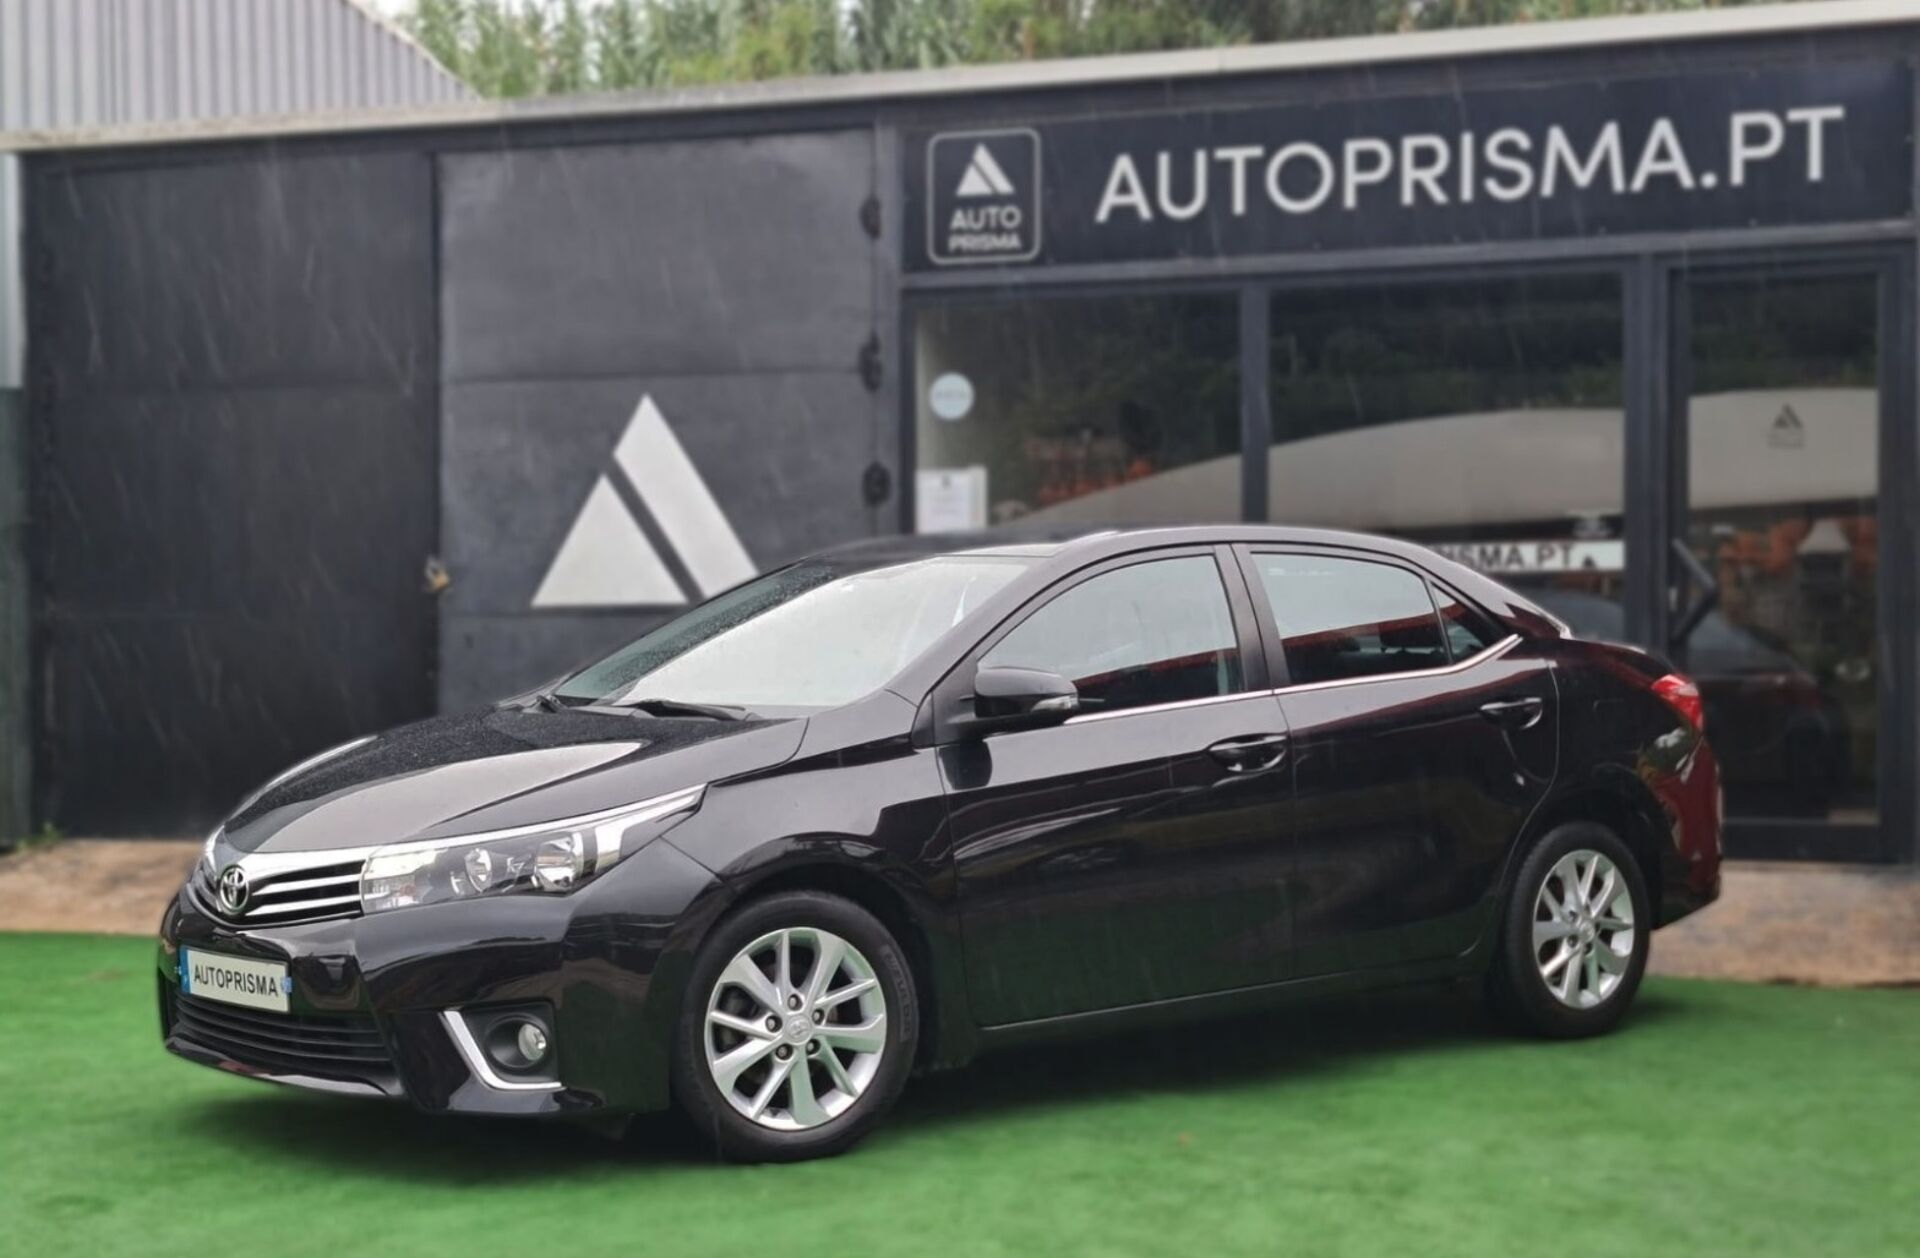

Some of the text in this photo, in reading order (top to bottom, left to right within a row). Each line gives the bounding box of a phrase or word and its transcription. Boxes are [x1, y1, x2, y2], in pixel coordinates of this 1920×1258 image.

[1096, 106, 1845, 223] AUTOPRISMA.PT
[950, 204, 1022, 230] AUTO
[948, 232, 1022, 252] PRISMA
[194, 964, 279, 997] AUTOPRISMA
